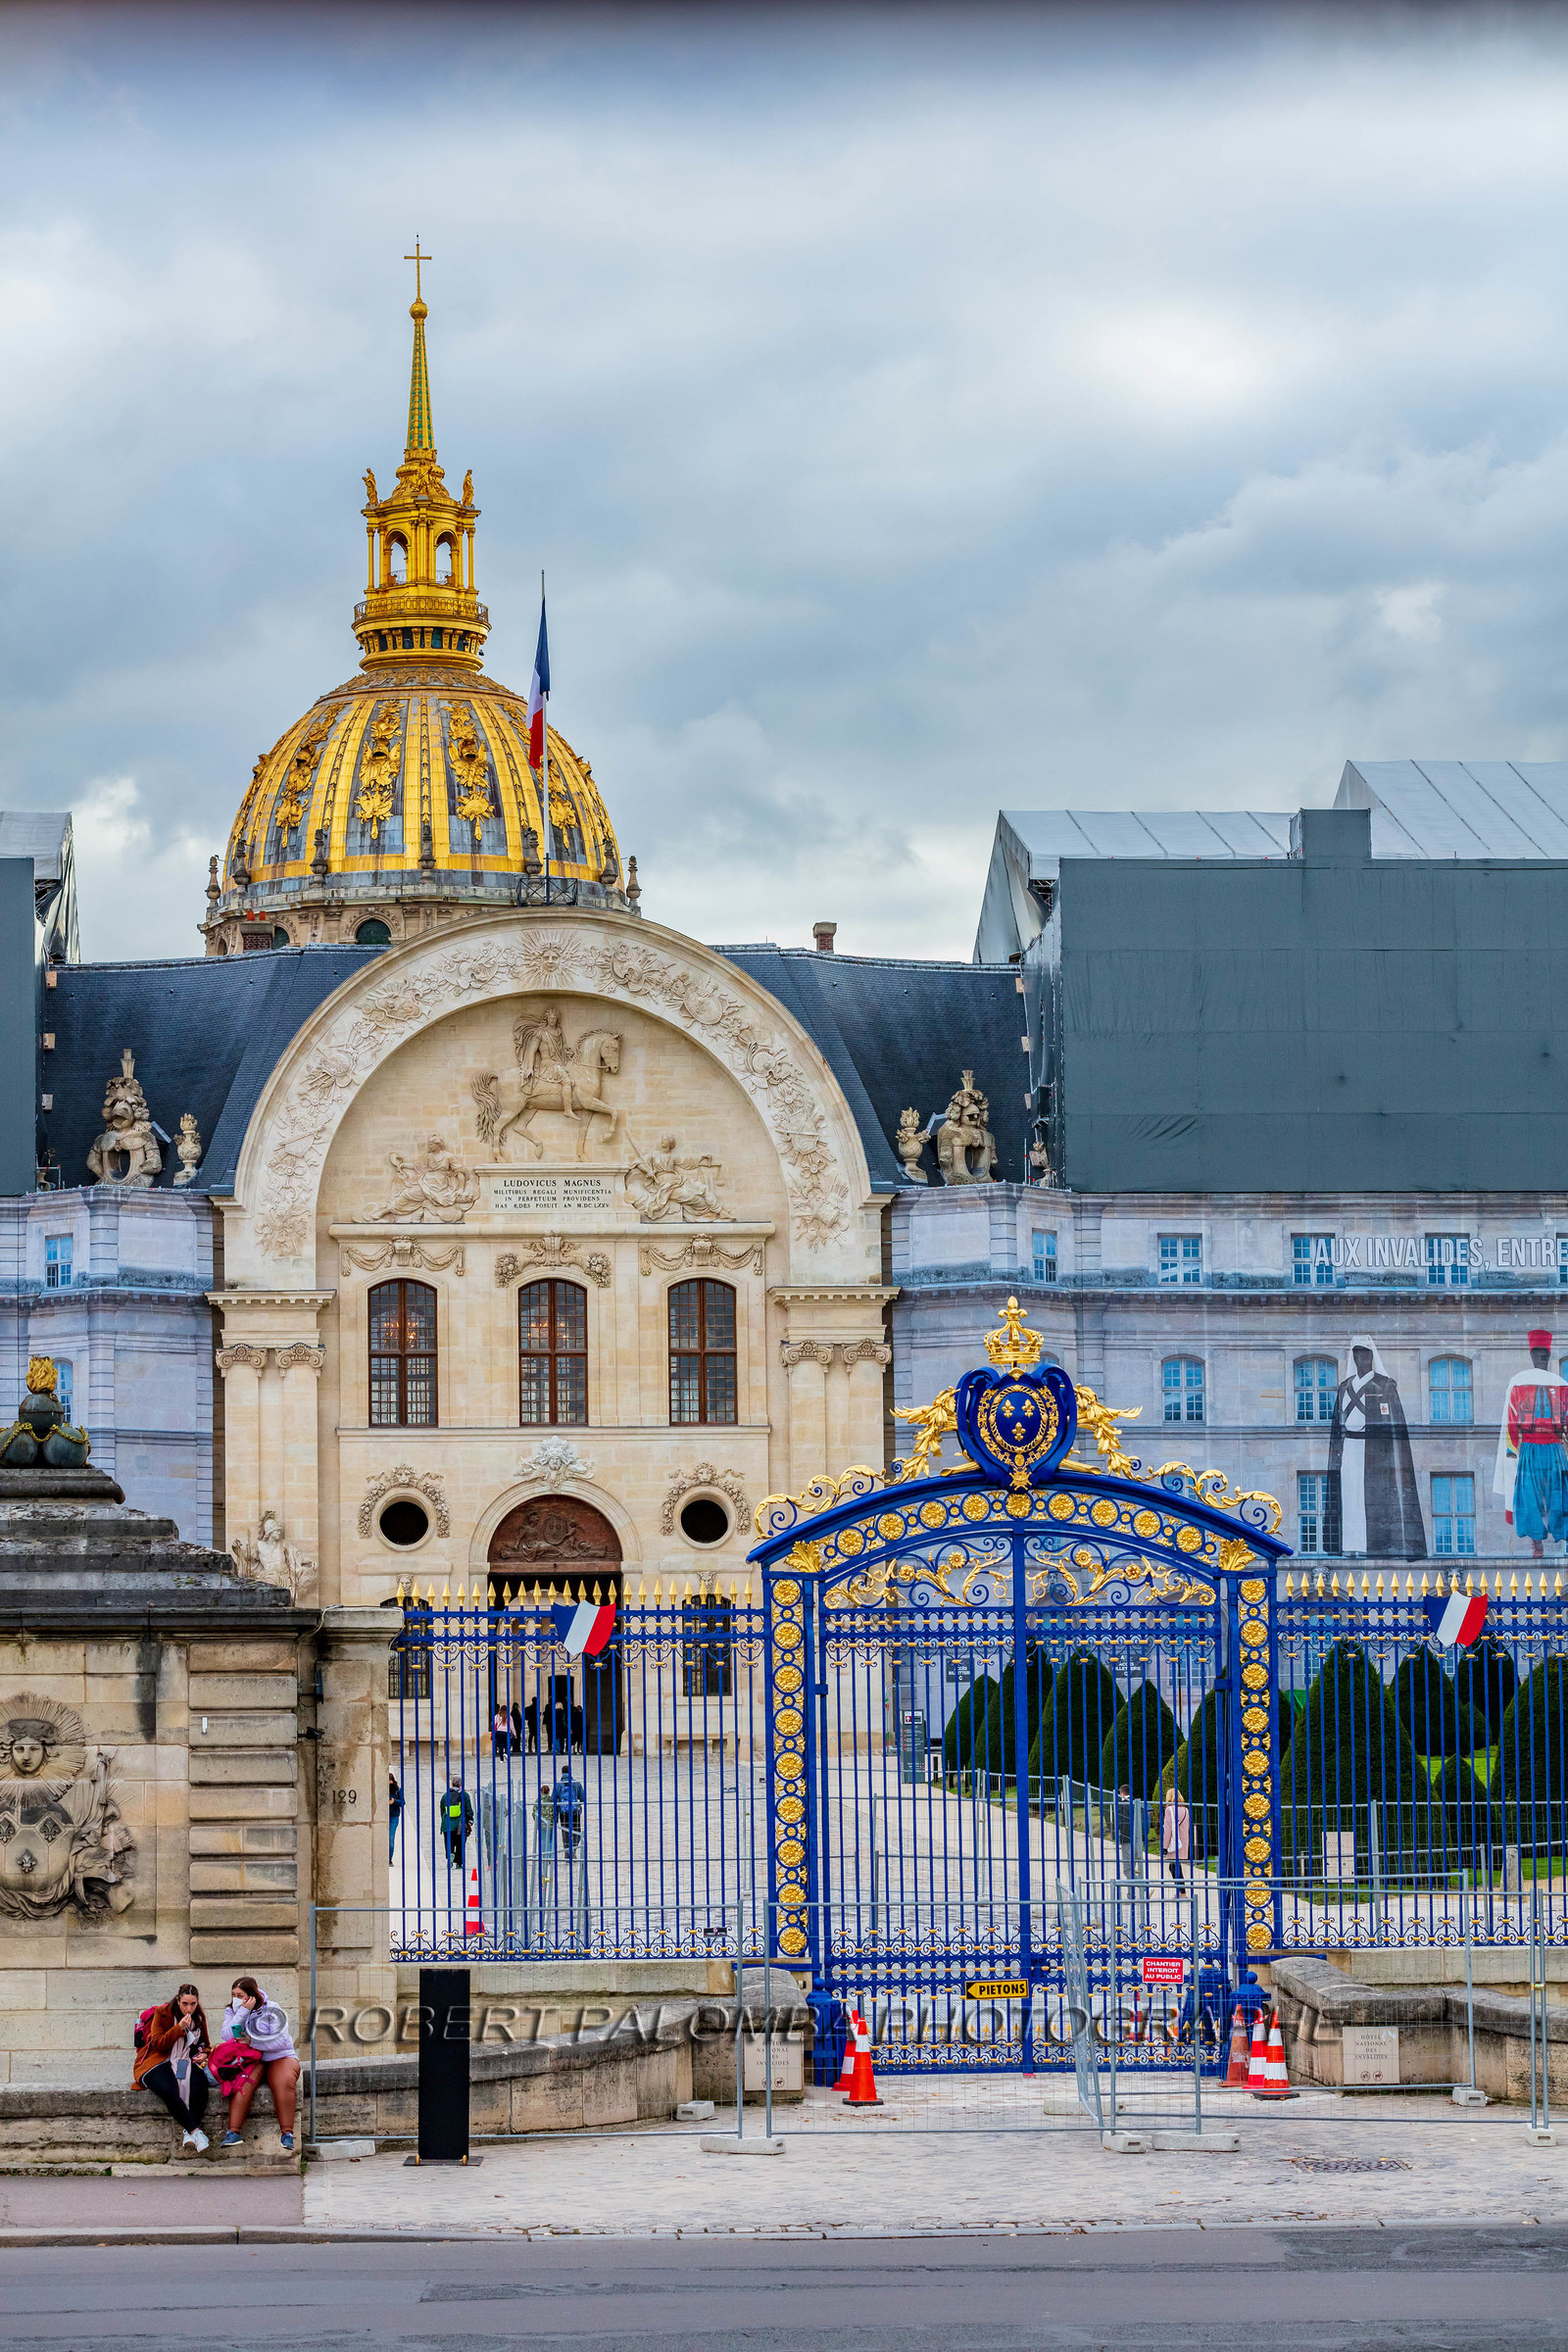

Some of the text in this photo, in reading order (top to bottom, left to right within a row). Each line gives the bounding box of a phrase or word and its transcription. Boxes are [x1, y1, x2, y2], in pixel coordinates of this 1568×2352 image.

[1314, 1238, 1568, 1271] AUX INVALIDES, ENTRE
[332, 1788, 358, 1804] 129
[979, 1984, 1025, 1995] PIETONS
